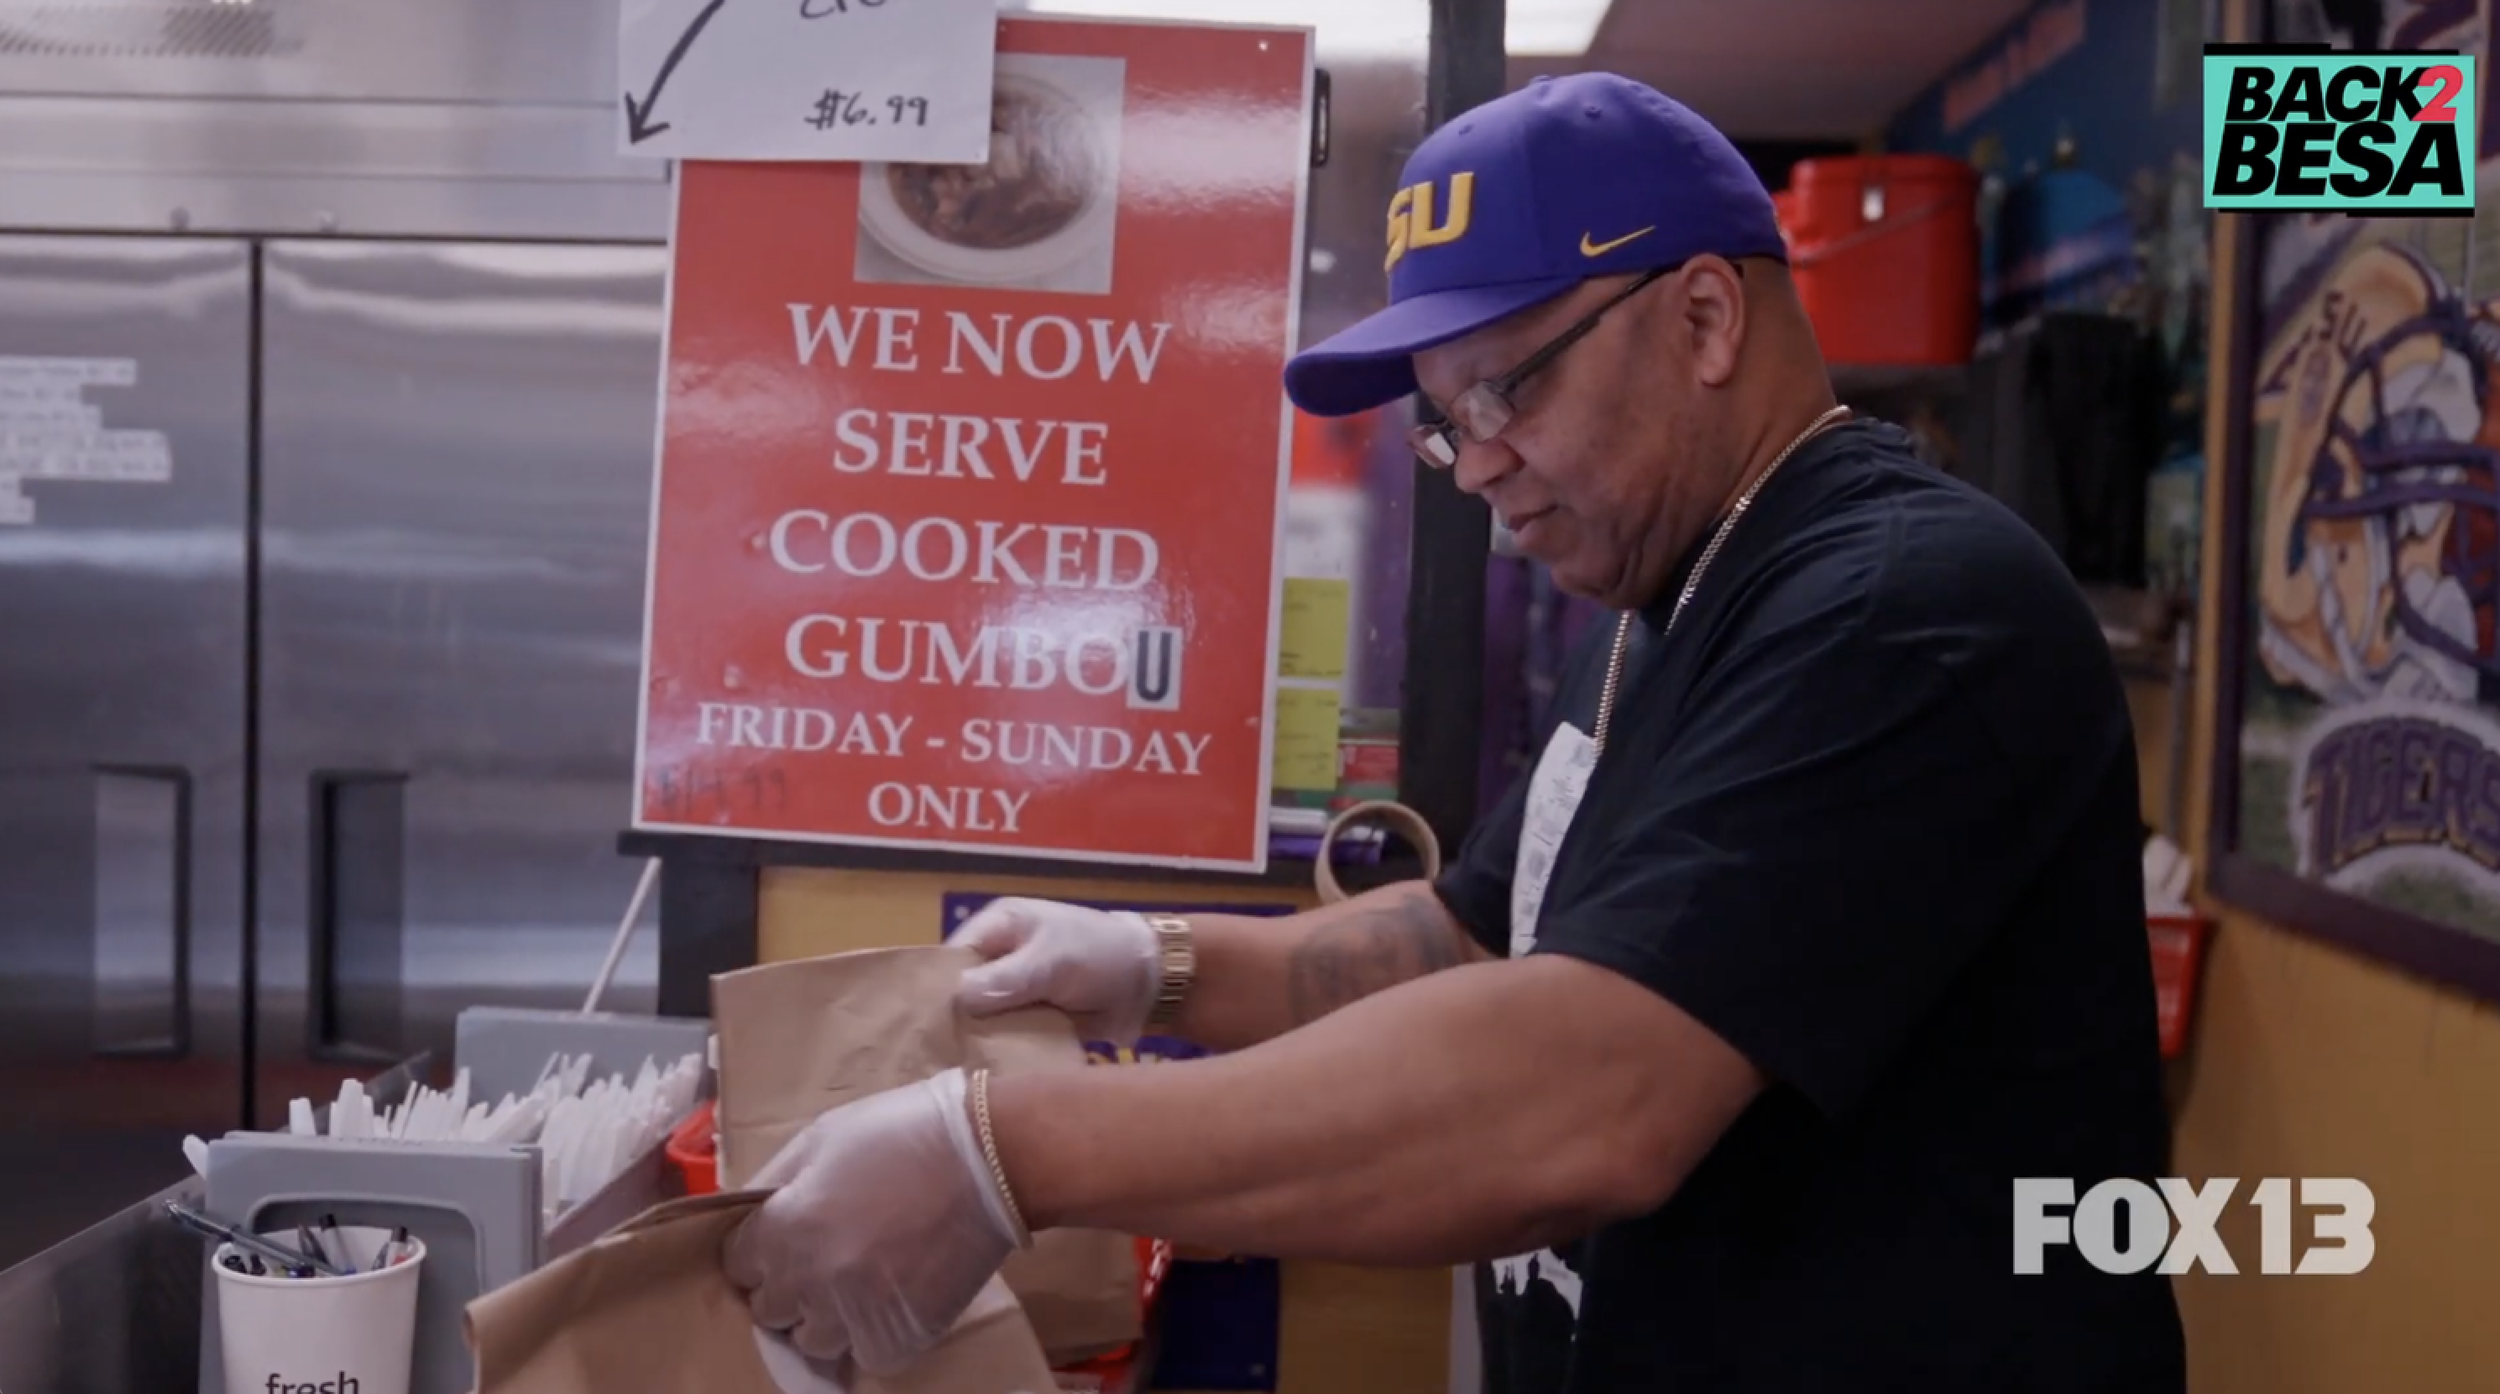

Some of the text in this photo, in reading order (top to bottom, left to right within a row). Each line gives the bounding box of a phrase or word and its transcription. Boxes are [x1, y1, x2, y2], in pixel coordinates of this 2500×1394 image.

[804, 88, 928, 131] $6.99
[786, 302, 1173, 384] WE NOW
[832, 407, 1109, 486] SERVE
[769, 508, 1160, 592] COOKED
[696, 701, 914, 757] FRIDAY
[960, 718, 1212, 776] SUNDAY
[867, 781, 1030, 833] ONLY
[264, 1369, 359, 1394] fresh
